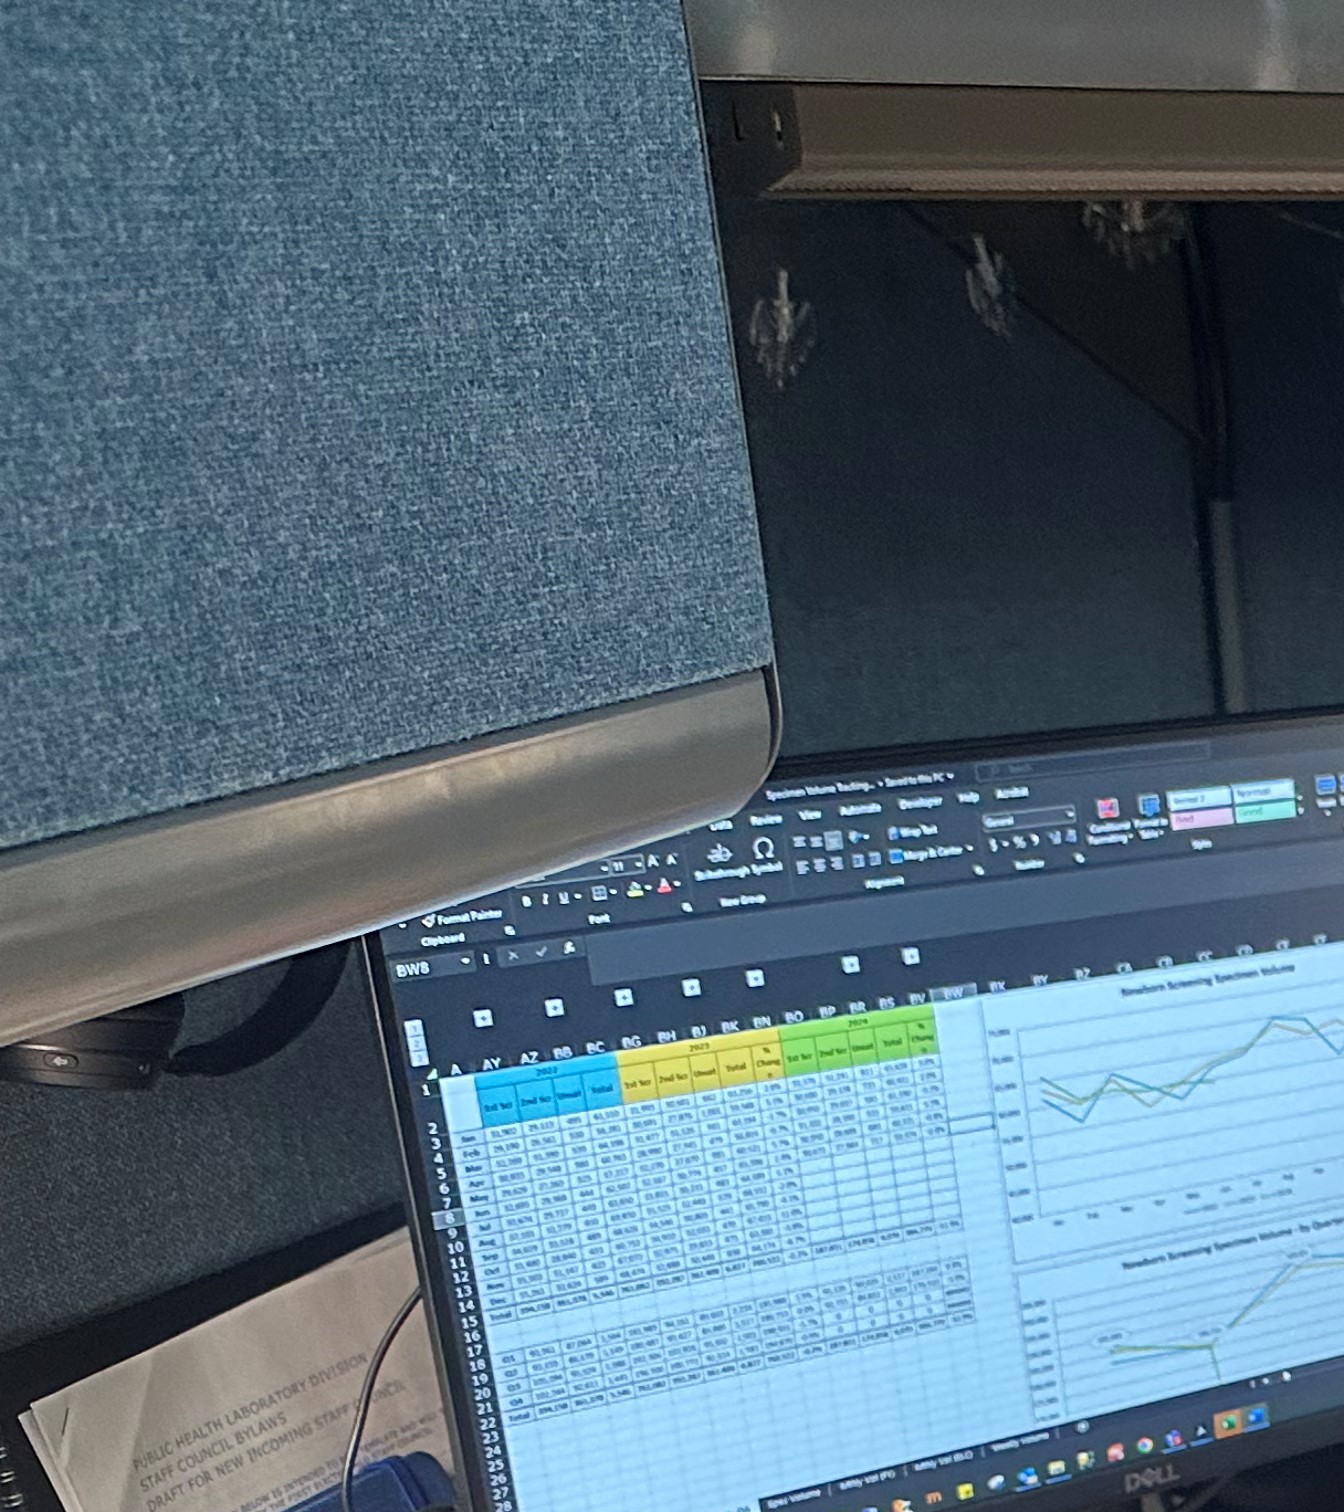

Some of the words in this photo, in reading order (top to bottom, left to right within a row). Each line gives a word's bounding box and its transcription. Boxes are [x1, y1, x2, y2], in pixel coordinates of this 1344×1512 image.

[438, 912, 469, 926] Format
[470, 909, 502, 922] Painter
[420, 933, 466, 947] Clipboard
[396, 961, 430, 978] BW8
[452, 1064, 462, 1075] A
[482, 1058, 500, 1071] AY
[520, 1052, 538, 1064] AZ
[553, 1046, 572, 1059] BB
[586, 1042, 605, 1054] BC
[622, 1036, 642, 1048] BG
[658, 1030, 676, 1042] BH
[692, 1026, 706, 1038] BJ
[722, 1022, 738, 1033] BK
[754, 1016, 771, 1028] BN
[820, 1006, 836, 1018] BP
[850, 1002, 867, 1014] BR
[879, 997, 894, 1009] BS
[910, 993, 926, 1004] BV
[536, 1066, 558, 1077] 2022
[422, 1084, 431, 1096] 1
[428, 1123, 438, 1134] 2
[431, 1138, 441, 1150] 3
[434, 1153, 444, 1164] 4
[437, 1168, 446, 1180] 5
[439, 1184, 450, 1194] 6
[443, 1198, 452, 1210] 7
[444, 1214, 455, 1224] 8
[447, 1228, 458, 1239] 9
[448, 1242, 464, 1254] 10
[450, 1258, 466, 1269] 11
[453, 1272, 469, 1284] 12
[456, 1286, 472, 1298] 13
[458, 1301, 475, 1312] 14
[462, 1317, 478, 1328] 15
[464, 1331, 481, 1342] 16
[468, 1345, 483, 1357] 17
[470, 1360, 486, 1371] 18
[472, 1374, 489, 1385] 19
[474, 1388, 492, 1400] 20
[131, 1443, 175, 1471] PUBLIC
[173, 1418, 224, 1449] HEALTH
[223, 1379, 308, 1426] LABORATORY
[307, 1351, 369, 1388] DIVISION
[476, 1402, 494, 1414] 21
[480, 1418, 496, 1430] 22
[482, 1432, 499, 1444] 23
[144, 1484, 187, 1512] DRAFT
[186, 1469, 214, 1491] FOR
[214, 1454, 246, 1477] NEW
[245, 1422, 314, 1462] INCOMING
[312, 1403, 352, 1431] STAFF
[350, 1378, 406, 1412] CUNCIL
[137, 1465, 177, 1492] STAFF
[175, 1436, 235, 1473] COUNCIL
[232, 1411, 289, 1445] BYLAWS
[485, 1446, 502, 1458] 24
[488, 1460, 504, 1472] 25
[281, 1465, 326, 1493] INTENDED
[490, 1474, 507, 1486] 26
[1125, 1463, 1180, 1493] DELL
[492, 1488, 509, 1499] 27
